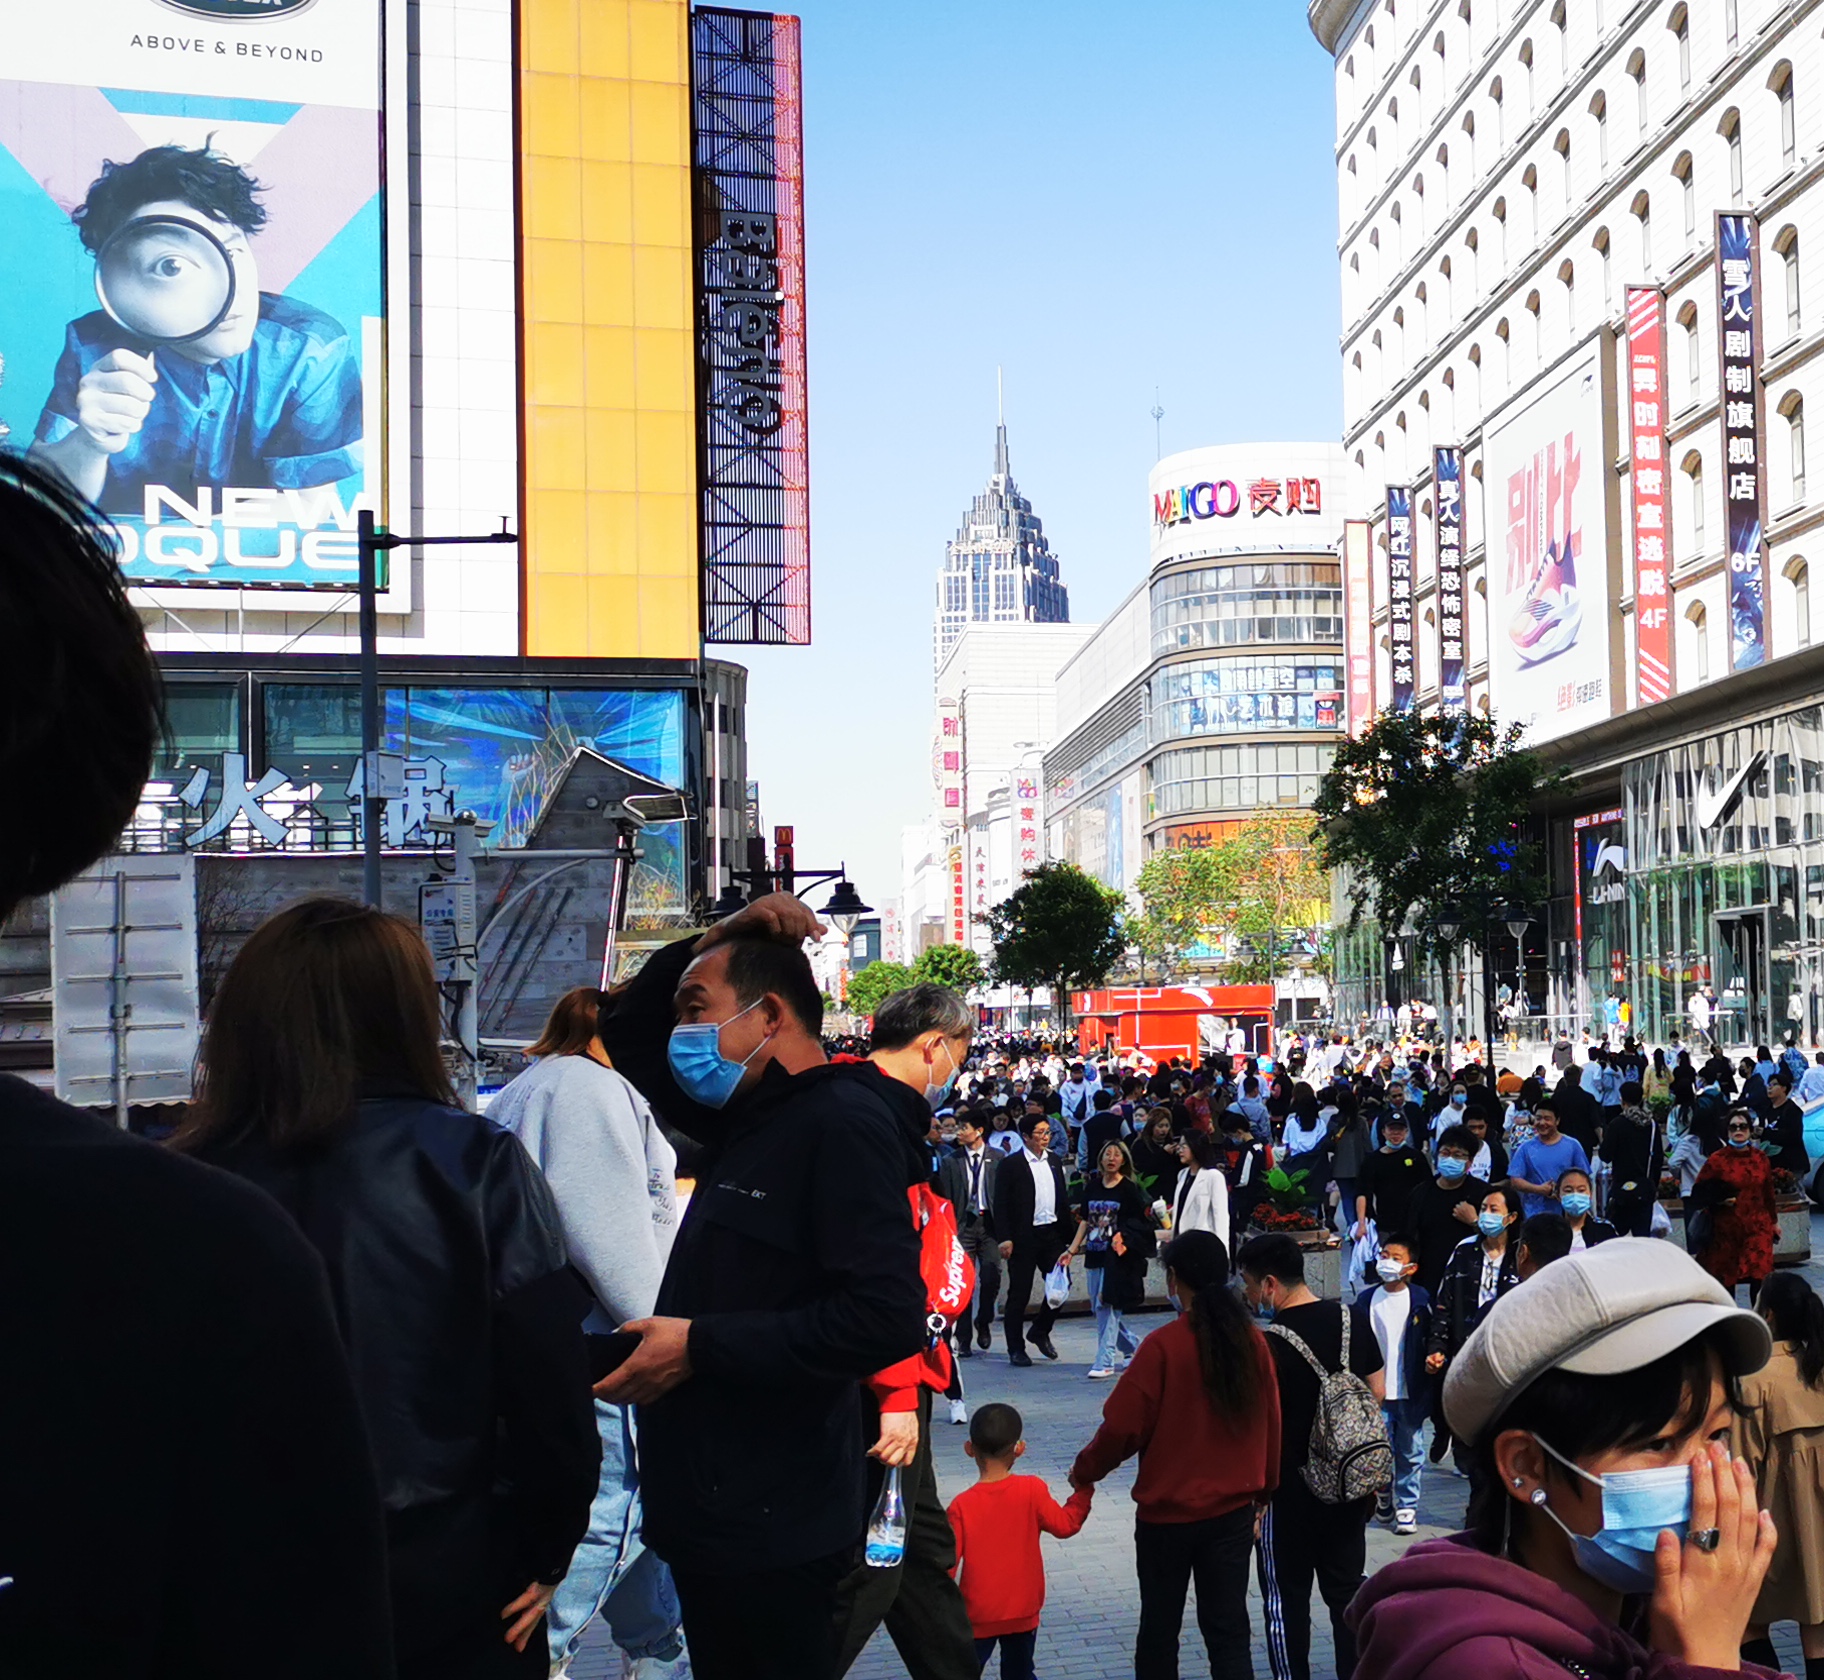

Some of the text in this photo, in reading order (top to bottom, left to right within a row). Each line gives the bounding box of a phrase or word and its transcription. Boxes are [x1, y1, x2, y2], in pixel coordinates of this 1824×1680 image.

[131, 34, 323, 63] ABOVE & BEYOND
[719, 212, 784, 427] Baleno
[144, 484, 371, 531] NEW
[1153, 479, 1241, 524] MAIGO
[1438, 480, 1463, 661] 真人演绎恐怖密室
[1731, 551, 1761, 573] 6F
[1389, 516, 1413, 685] 网红沉浸式剧本杀
[1639, 608, 1668, 629] 4F
